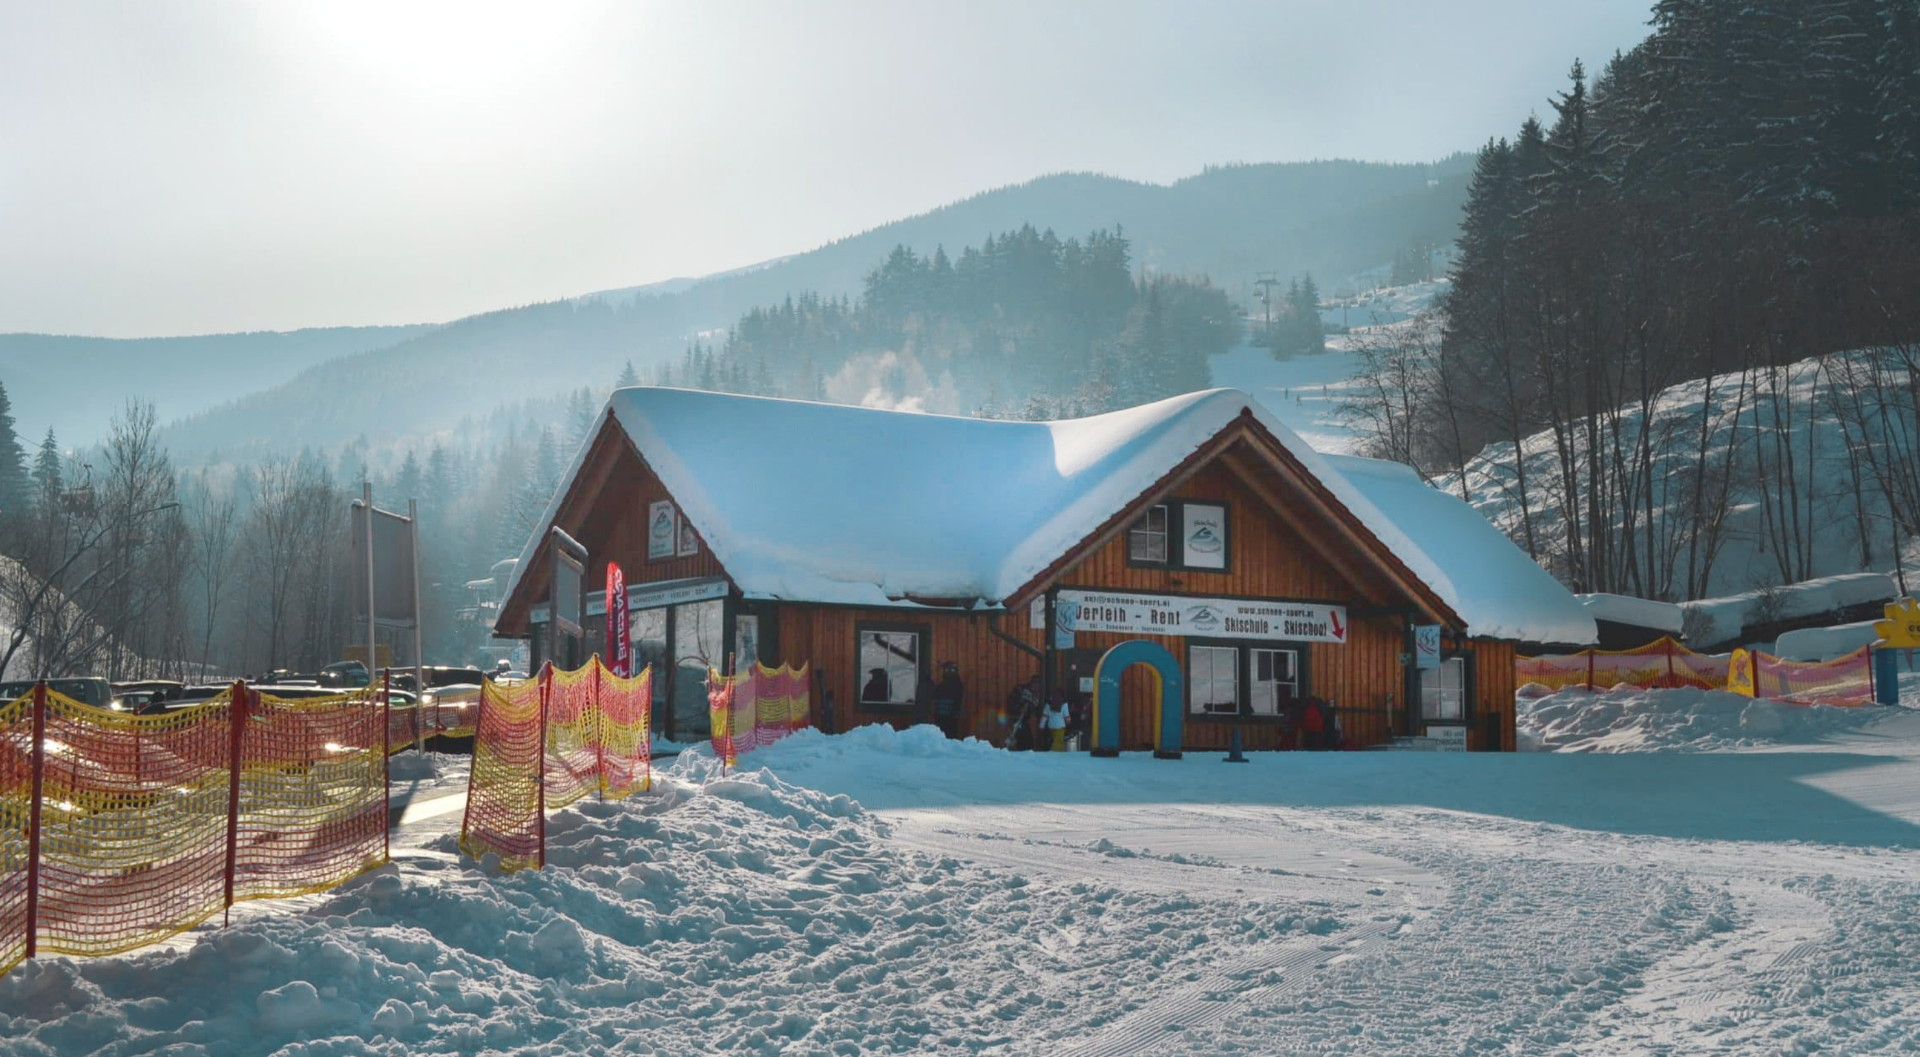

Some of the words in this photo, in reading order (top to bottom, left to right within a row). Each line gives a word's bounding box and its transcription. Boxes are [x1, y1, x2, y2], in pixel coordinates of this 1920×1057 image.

[1151, 609, 1180, 625] Rent
[1224, 617, 1269, 634] Skischule
[1284, 620, 1327, 637] Skischool
